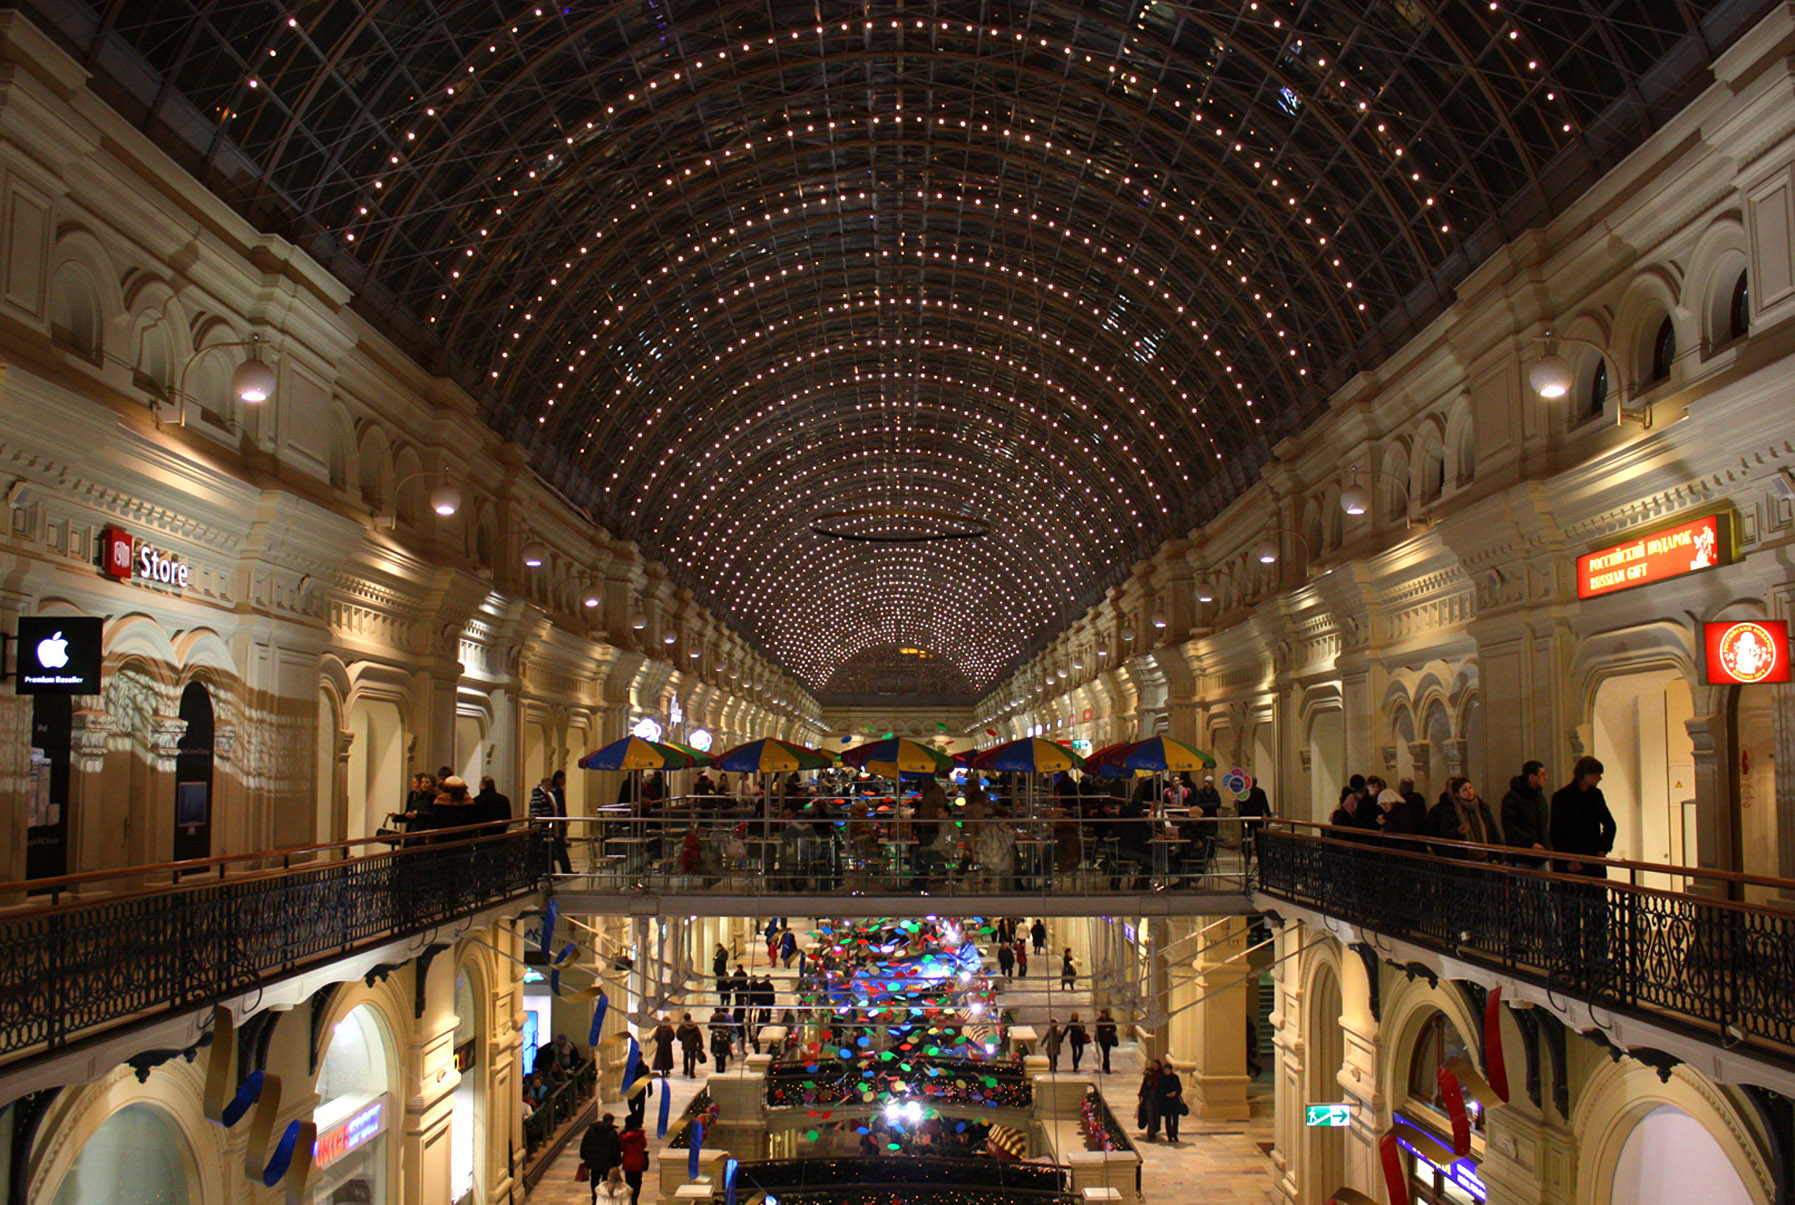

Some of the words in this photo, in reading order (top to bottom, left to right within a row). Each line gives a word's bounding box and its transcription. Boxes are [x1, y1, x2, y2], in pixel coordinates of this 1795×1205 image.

[141, 546, 188, 587] Store
[1589, 541, 1645, 572] РОССИЙСКИЙ
[1648, 530, 1692, 555] ПОДАРОК
[1590, 569, 1625, 590] RUSSIAN
[1627, 562, 1647, 580] GIFT
[24, 675, 55, 683] Premium
[55, 675, 83, 683] Reseller
